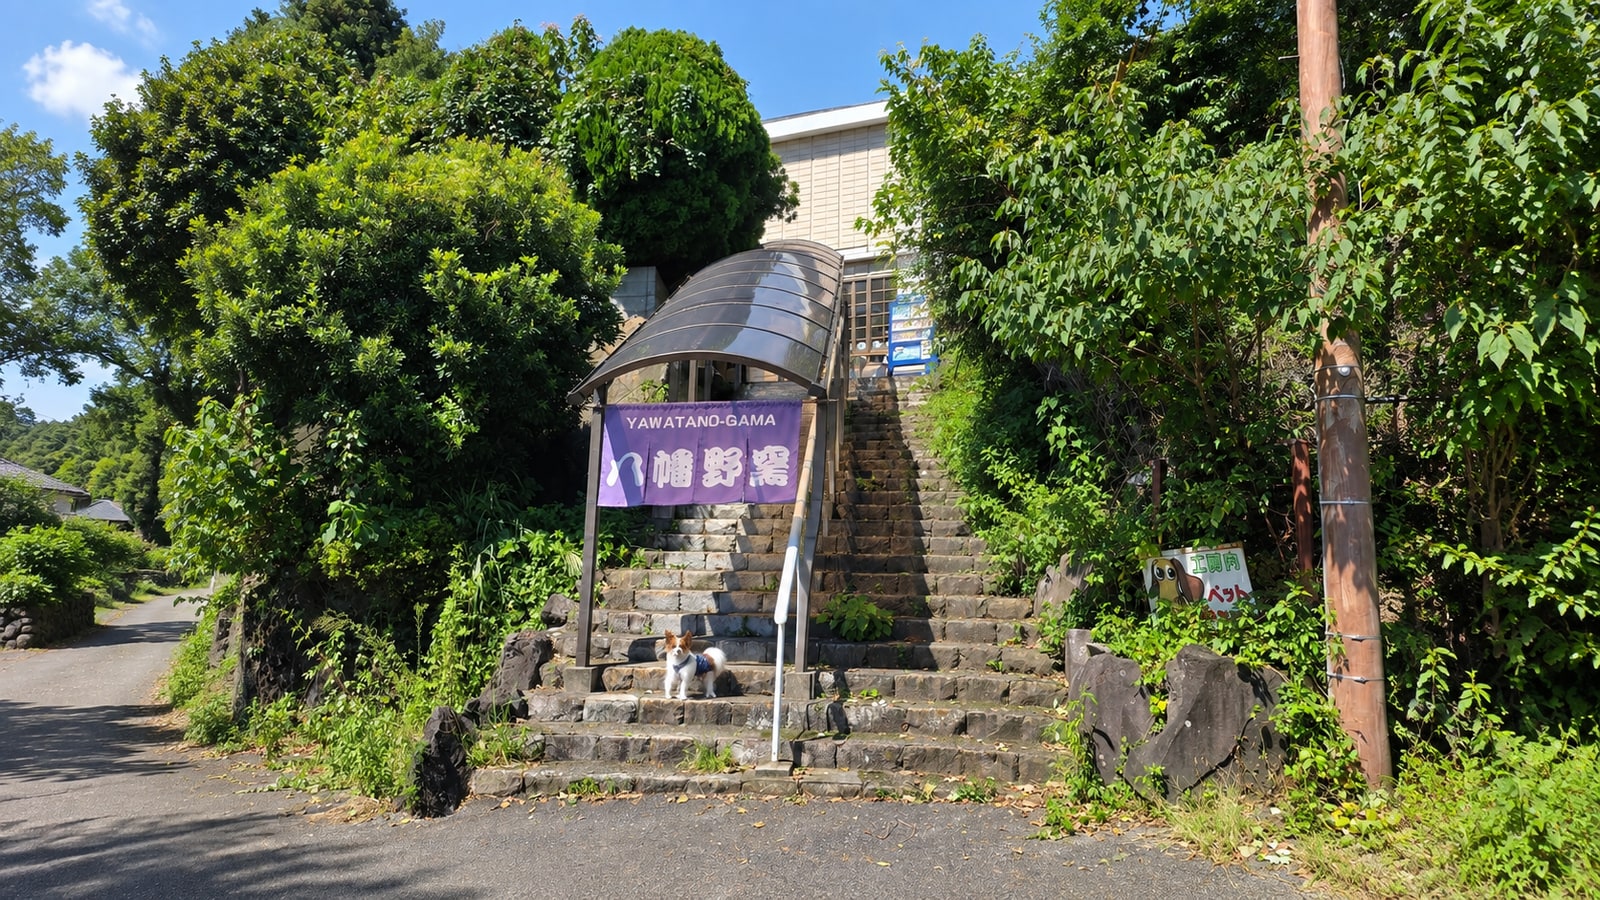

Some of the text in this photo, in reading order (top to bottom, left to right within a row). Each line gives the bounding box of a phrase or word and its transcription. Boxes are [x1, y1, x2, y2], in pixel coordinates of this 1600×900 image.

[627, 414, 776, 429] YAWATANO-GAMA
[606, 445, 790, 488] 八幡野窯
